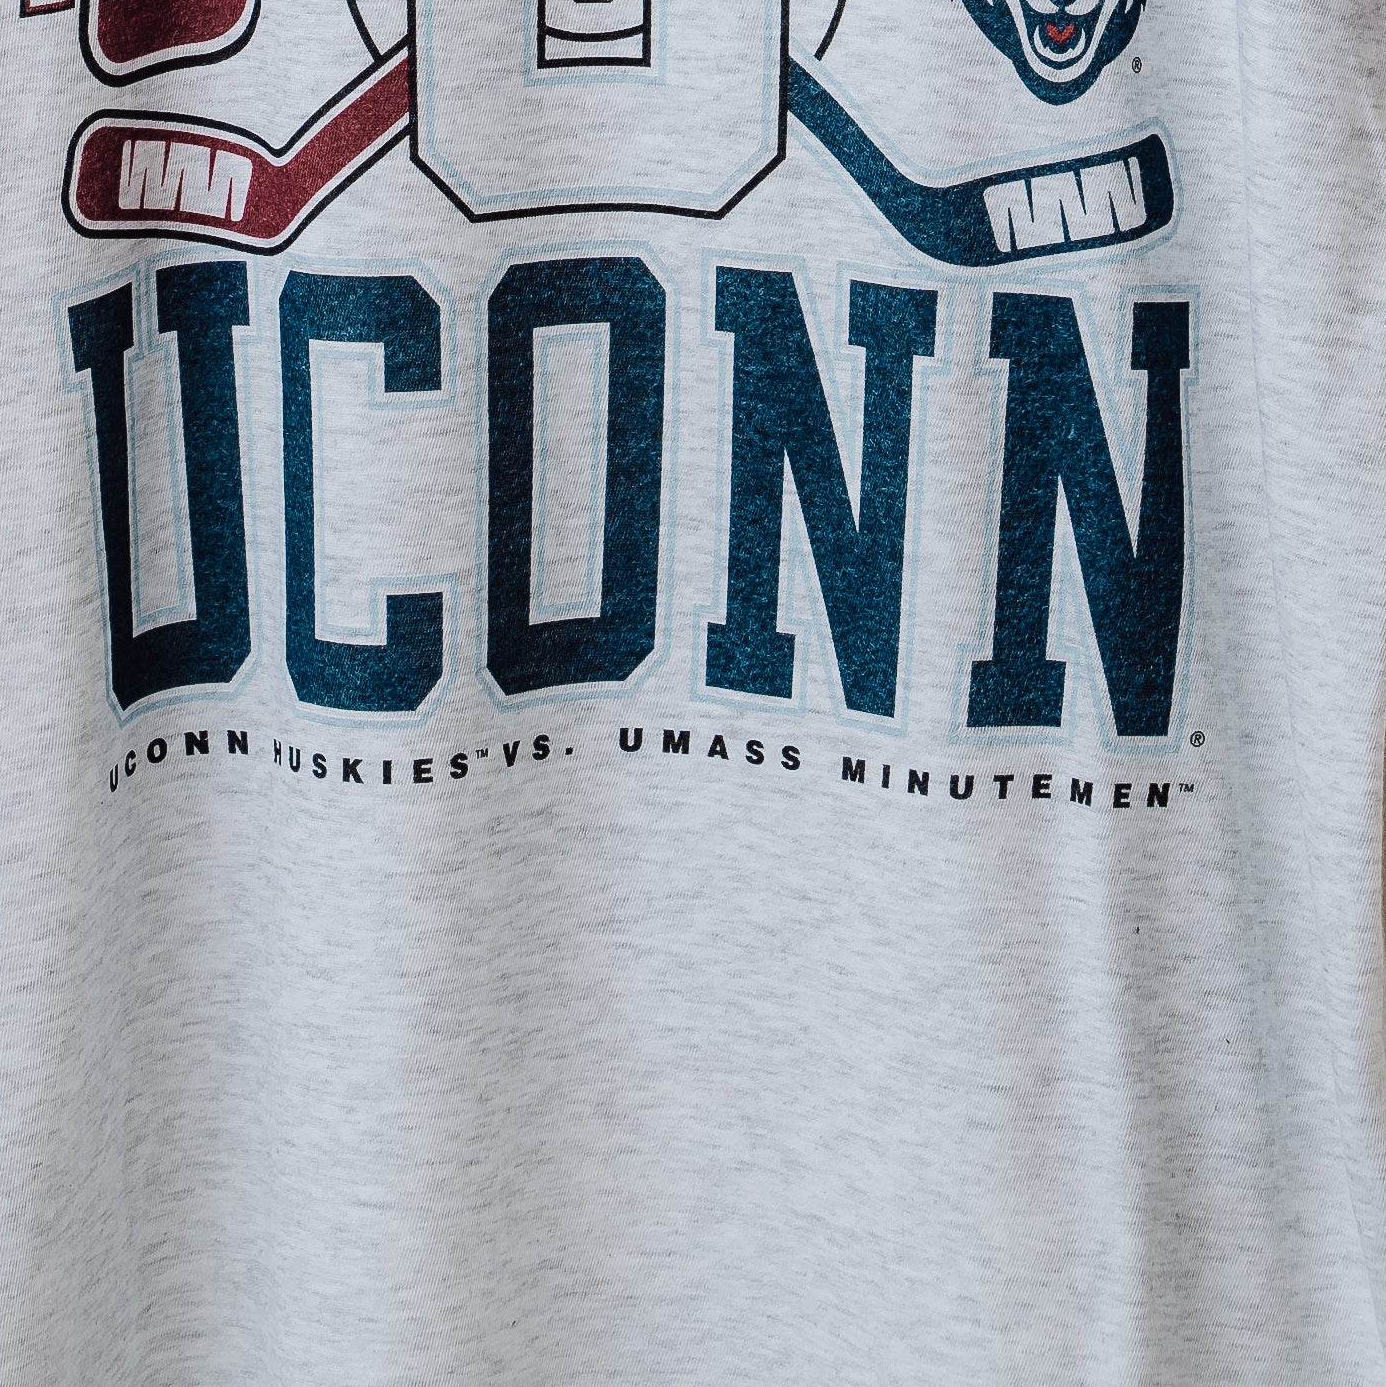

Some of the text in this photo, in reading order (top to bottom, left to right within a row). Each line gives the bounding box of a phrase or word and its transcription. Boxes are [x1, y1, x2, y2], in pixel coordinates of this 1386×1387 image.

[63, 251, 1196, 741] UCONN
[109, 729, 250, 793] UCONN
[503, 734, 575, 768] VS.
[618, 727, 801, 771] UMASS
